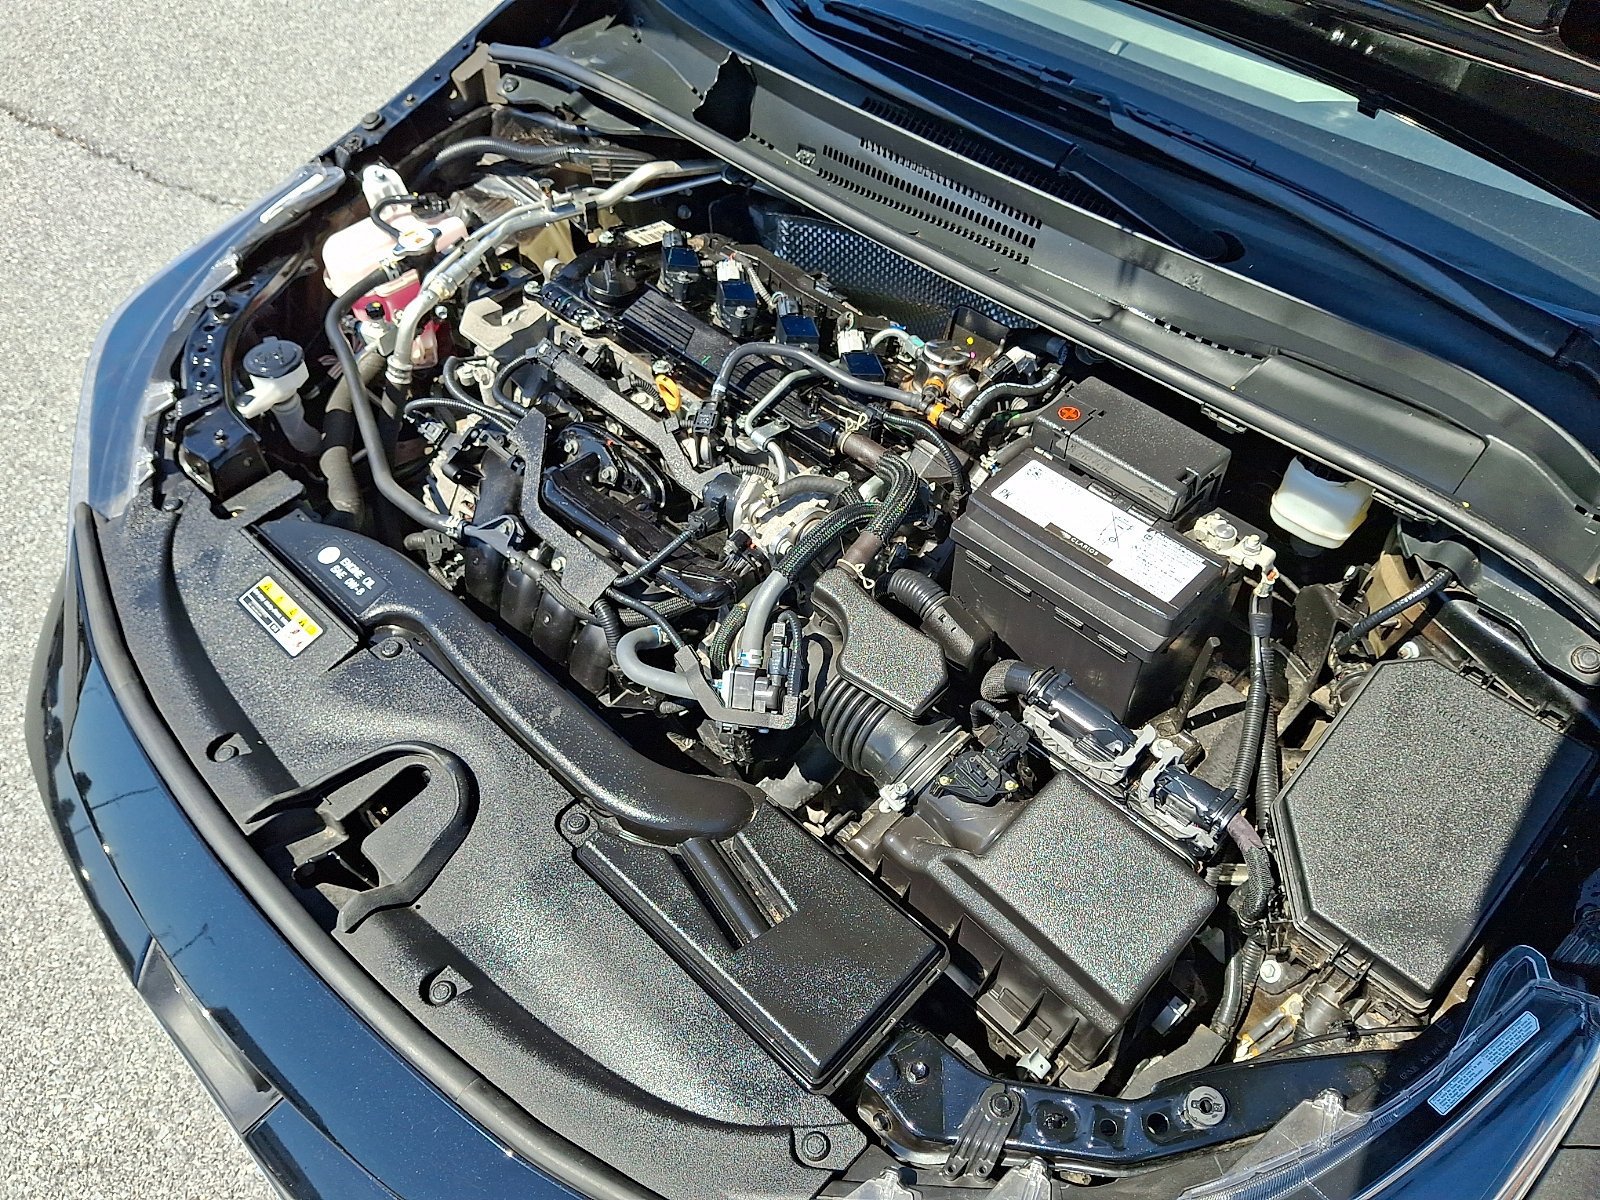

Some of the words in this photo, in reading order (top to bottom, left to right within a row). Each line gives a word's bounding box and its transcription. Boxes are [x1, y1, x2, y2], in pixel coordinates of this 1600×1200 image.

[1070, 537, 1099, 556] CLARIOS
[329, 565, 348, 580] SAE
[339, 557, 366, 580] ENGINE
[361, 576, 376, 590] OIL
